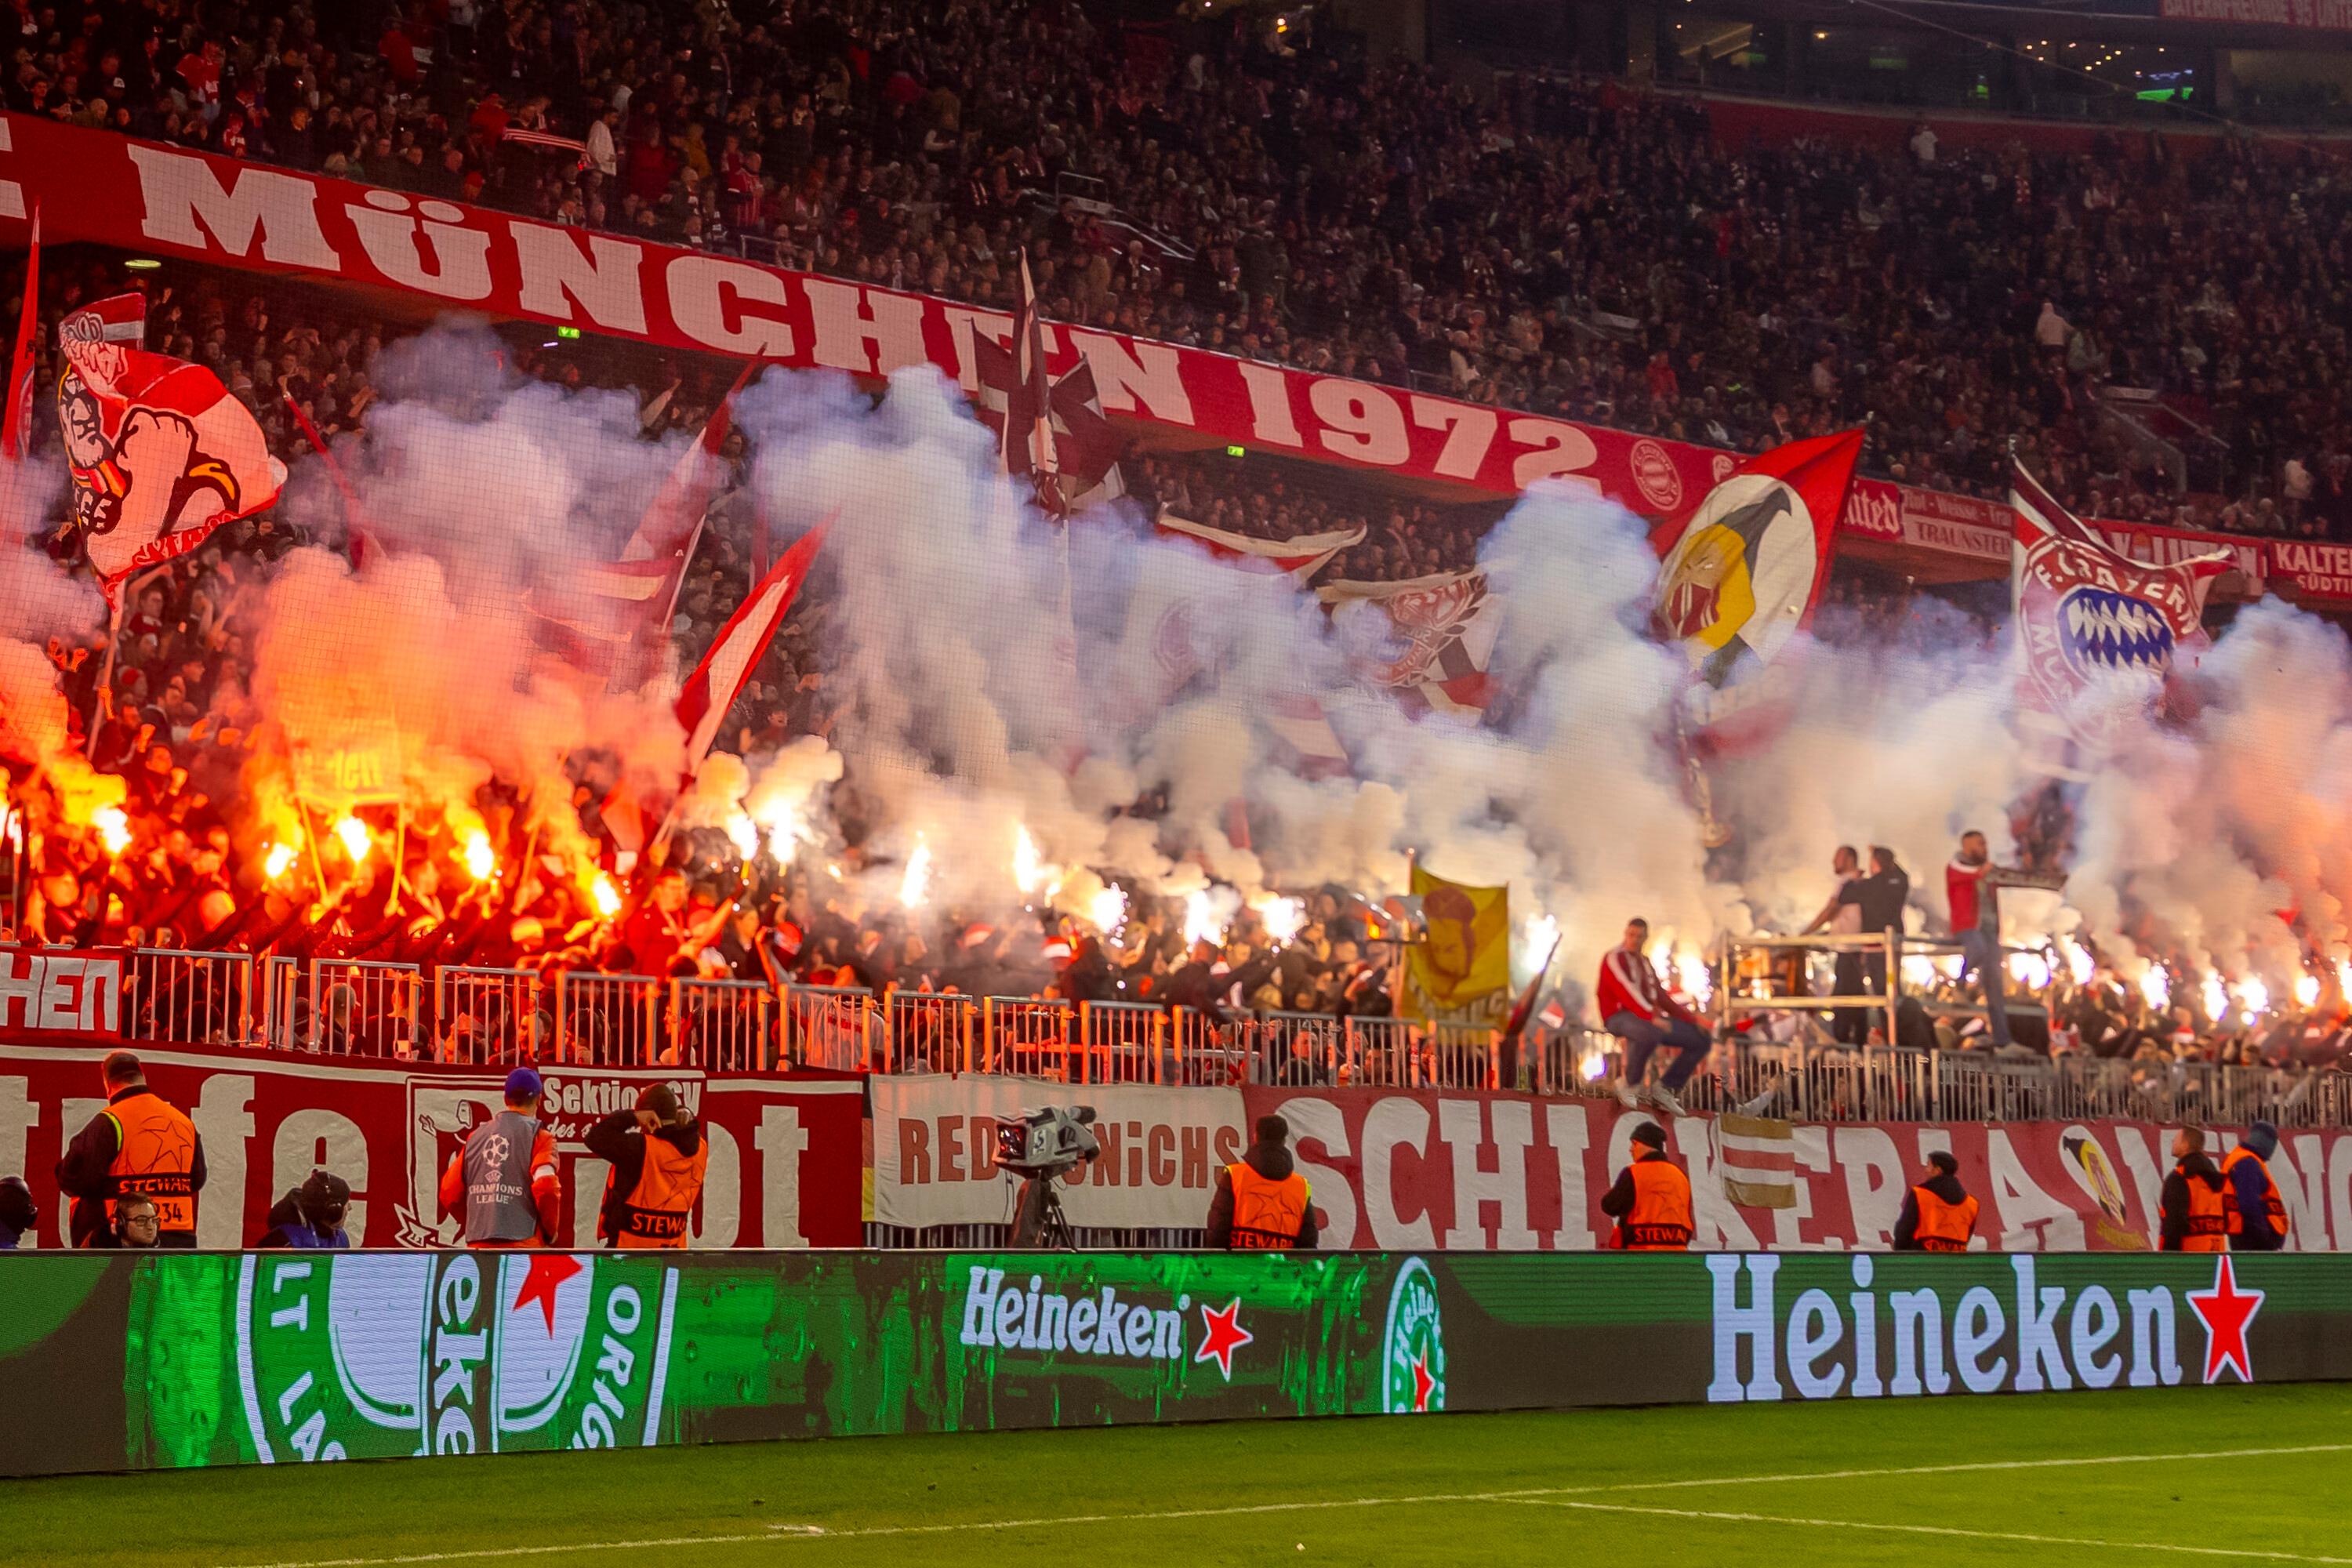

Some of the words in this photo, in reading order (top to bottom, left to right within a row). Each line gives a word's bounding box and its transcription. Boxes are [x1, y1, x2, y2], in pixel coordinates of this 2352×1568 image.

[1239, 362, 1601, 495] 1972
[543, 1077, 644, 1115] Sektio
[469, 1183, 524, 1196] CHAMIONS
[899, 1116, 999, 1185] RED
[960, 1265, 1182, 1359] Heineken
[1705, 1254, 2183, 1403] Heineken
